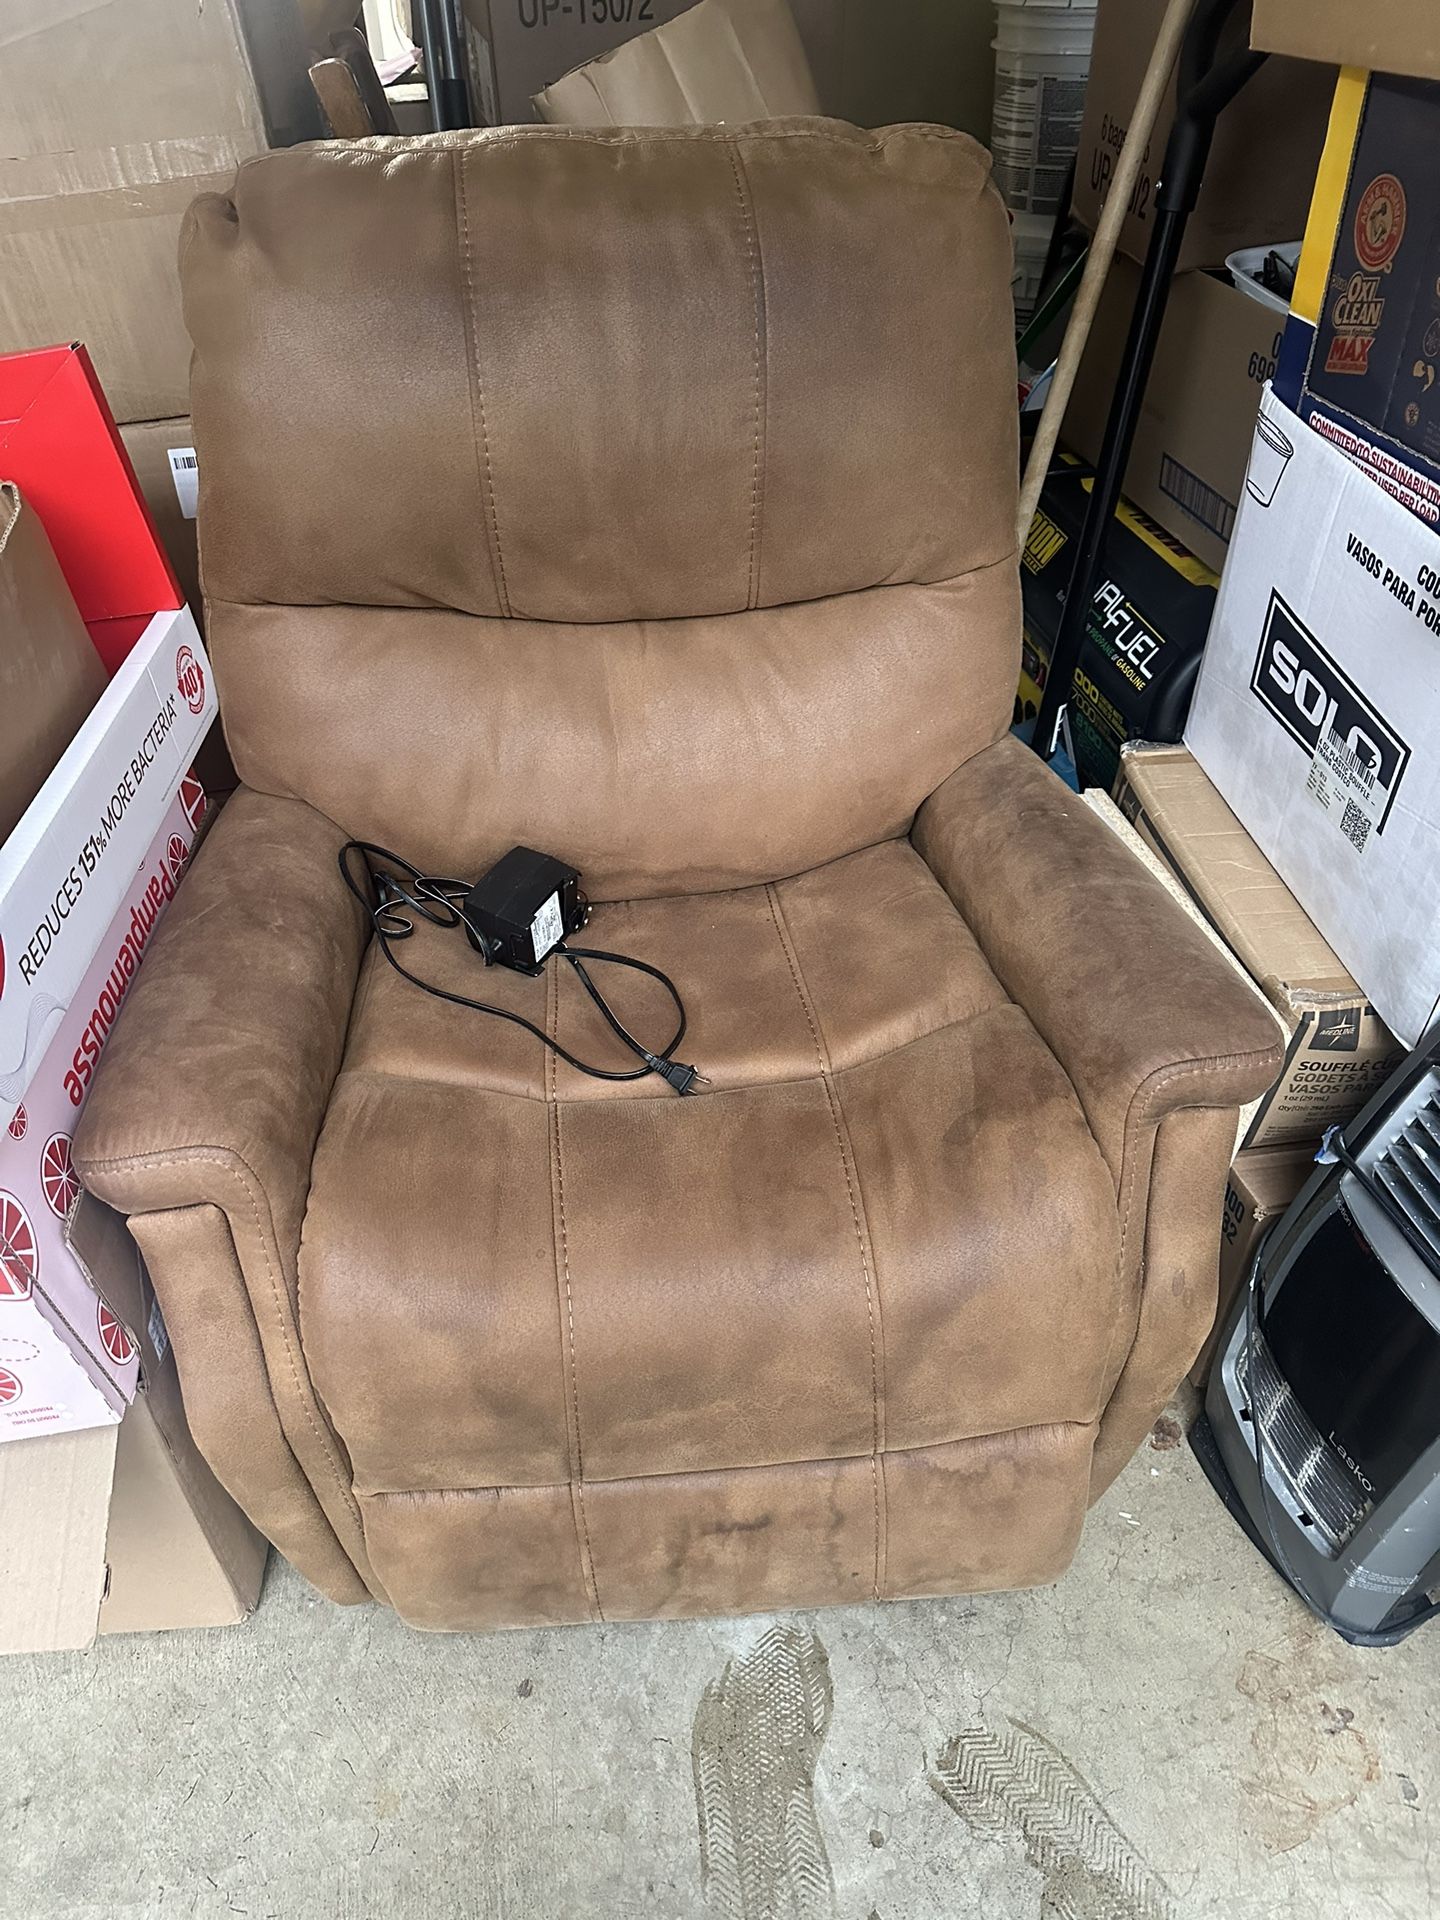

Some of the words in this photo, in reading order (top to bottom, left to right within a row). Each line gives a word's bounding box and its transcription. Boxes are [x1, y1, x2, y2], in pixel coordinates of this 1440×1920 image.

[1347, 274, 1376, 303] OXI
[1333, 297, 1382, 326] CLEAN
[1329, 337, 1373, 362] MAX
[1310, 412, 1358, 454] COMMITTED
[1356, 440, 1371, 460] TO
[1415, 498, 1439, 522] LOAD
[1346, 532, 1383, 579] VASOS
[1382, 567, 1416, 612] PARA
[1115, 657, 1147, 692] GASOLINE
[1316, 744, 1332, 766] TRANS
[1331, 763, 1351, 788] COSTCO
[1329, 750, 1349, 776] PLASTIC
[1348, 772, 1371, 801] SOUFFLE
[18, 873, 84, 987] REDUCES
[77, 829, 108, 878] 151%
[100, 770, 137, 840] MORE
[63, 859, 176, 1107] Pamplemousse
[1319, 1026, 1356, 1036] MEDLINE
[1293, 1073, 1357, 1084] GODETS
[1297, 1059, 1370, 1072] SOUFFLÉ
[1289, 1084, 1341, 1094] VASOS
[1328, 1430, 1373, 1493] Lasko
